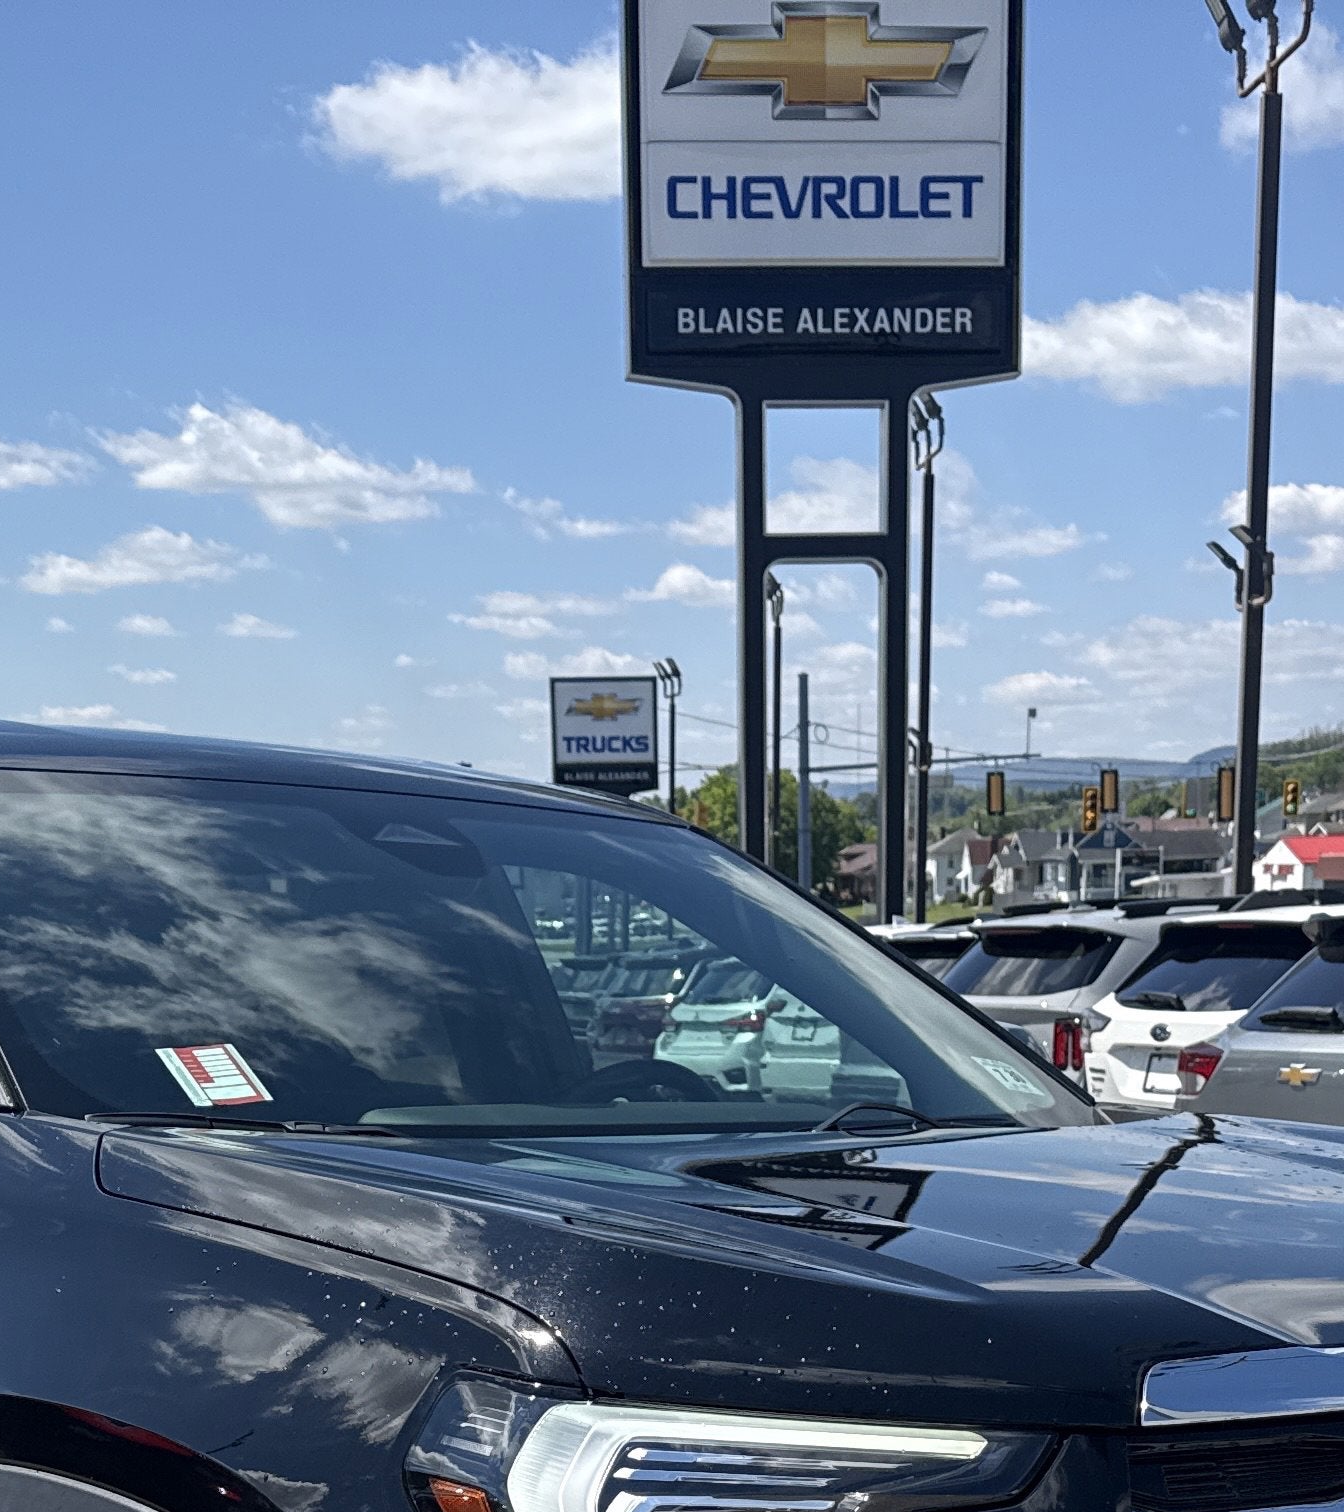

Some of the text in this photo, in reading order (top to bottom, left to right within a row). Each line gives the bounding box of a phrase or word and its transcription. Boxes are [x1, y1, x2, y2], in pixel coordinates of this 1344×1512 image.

[667, 175, 983, 219] CHEVROLET
[677, 307, 973, 334] BLAISE ALEXANDER
[562, 736, 649, 753] TRUCKS
